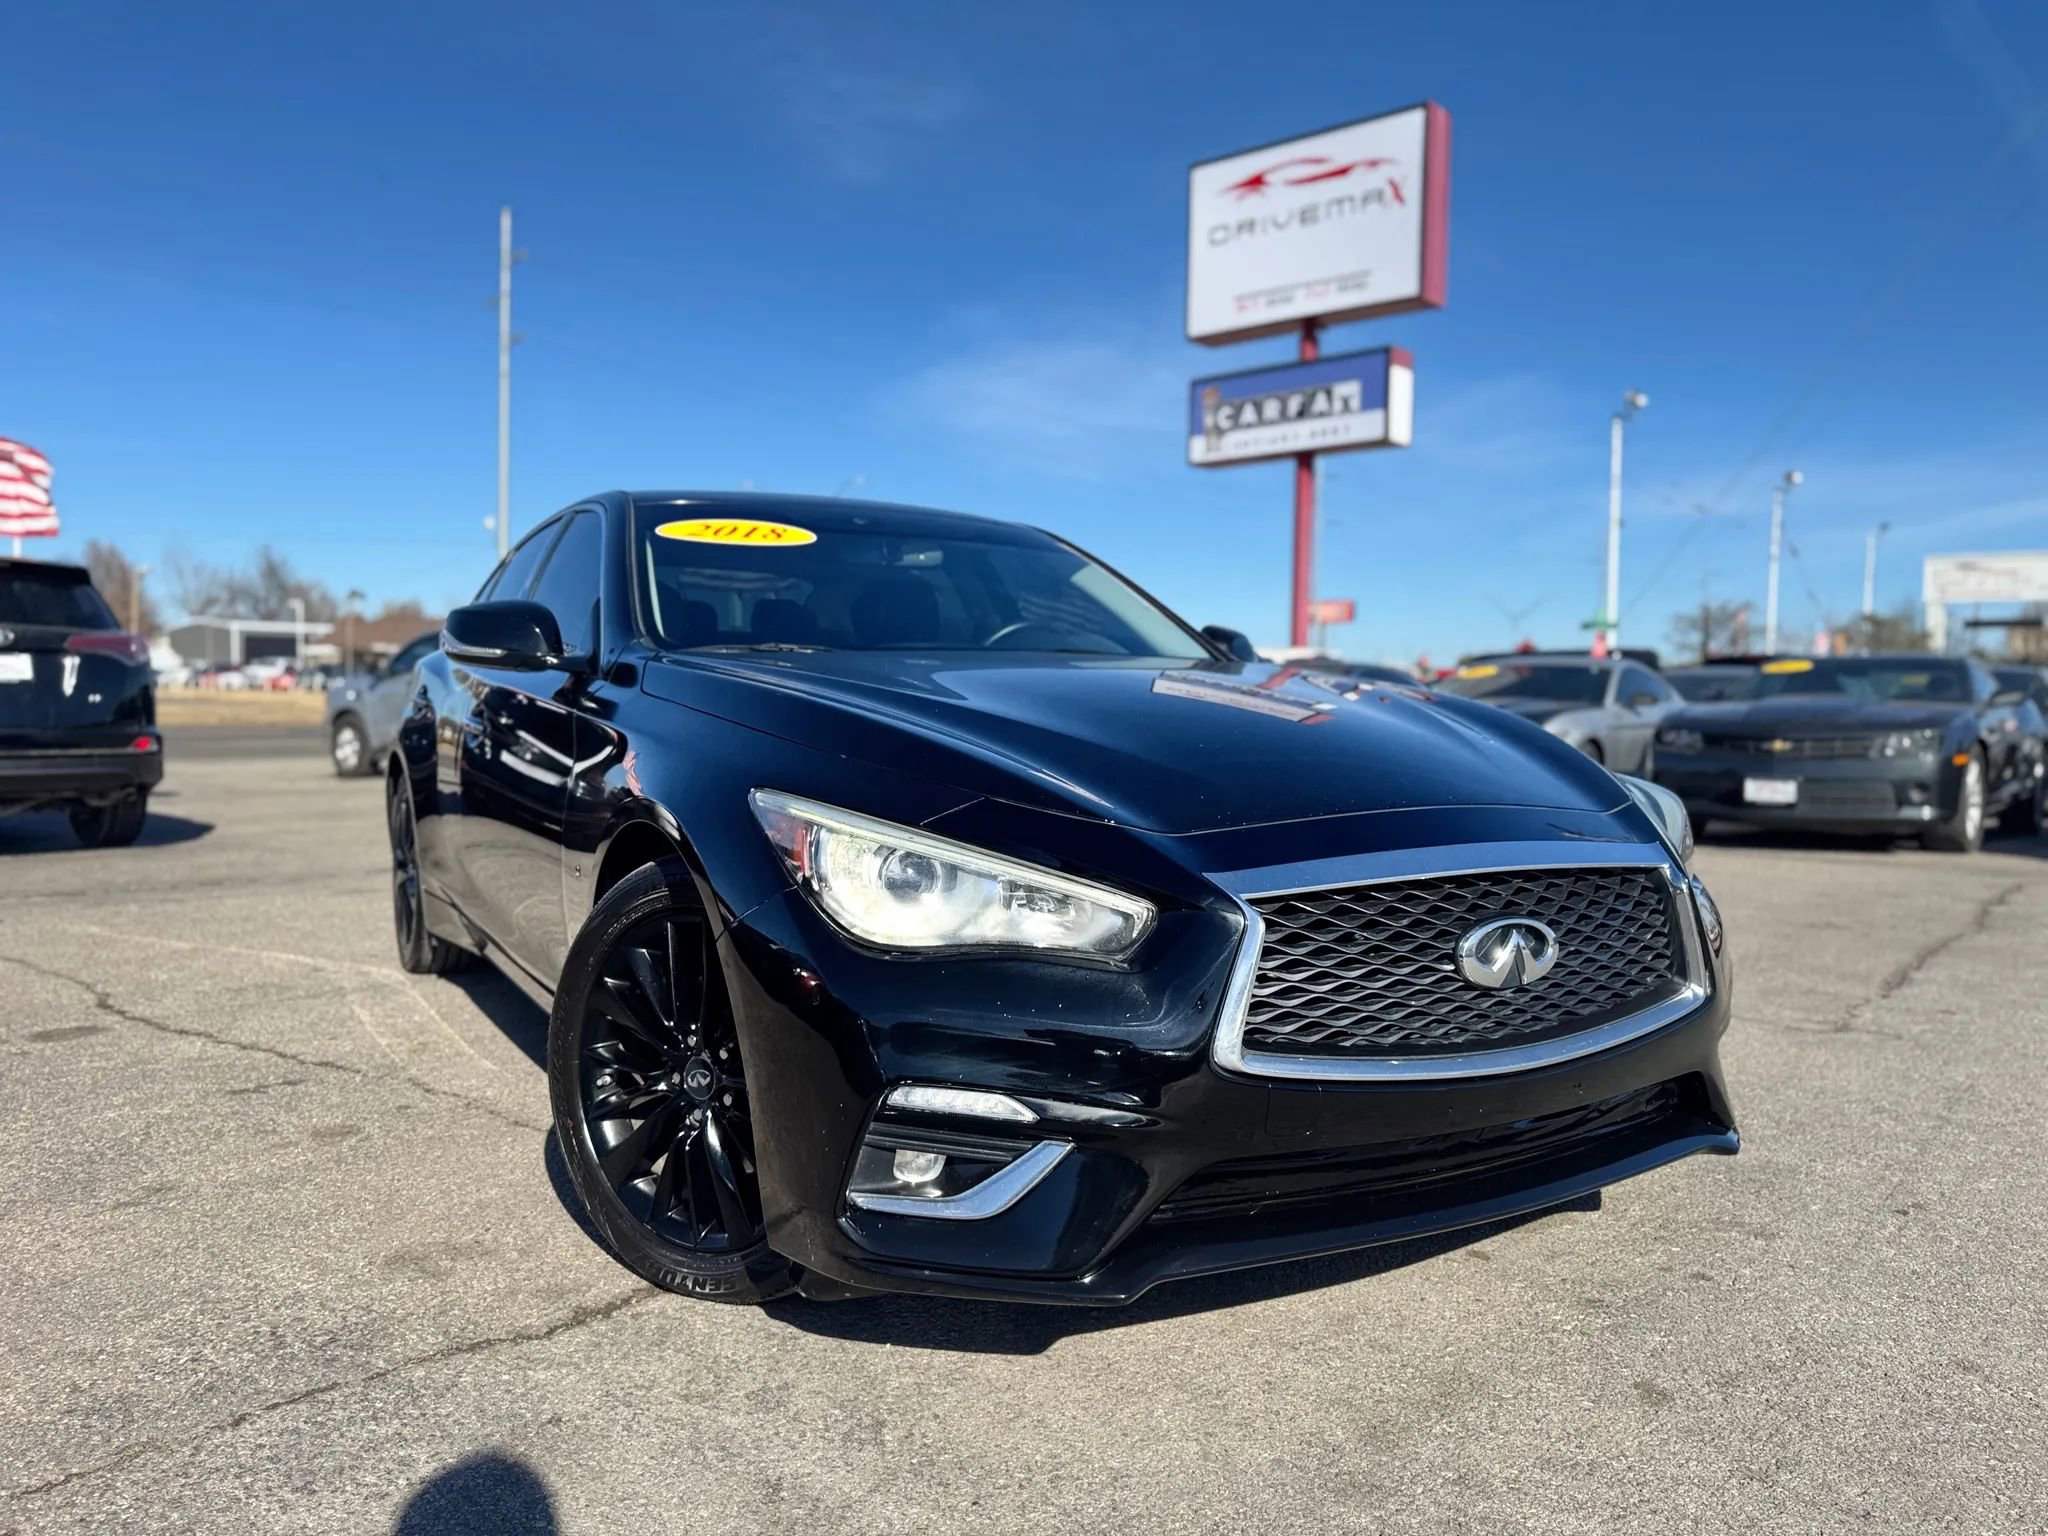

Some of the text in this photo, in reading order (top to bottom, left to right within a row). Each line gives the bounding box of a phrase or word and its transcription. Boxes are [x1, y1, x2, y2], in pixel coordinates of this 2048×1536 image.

[1207, 177, 1407, 247] DRIVEMAX
[1215, 390, 1359, 431] CARFAX
[686, 524, 788, 540] 2018
